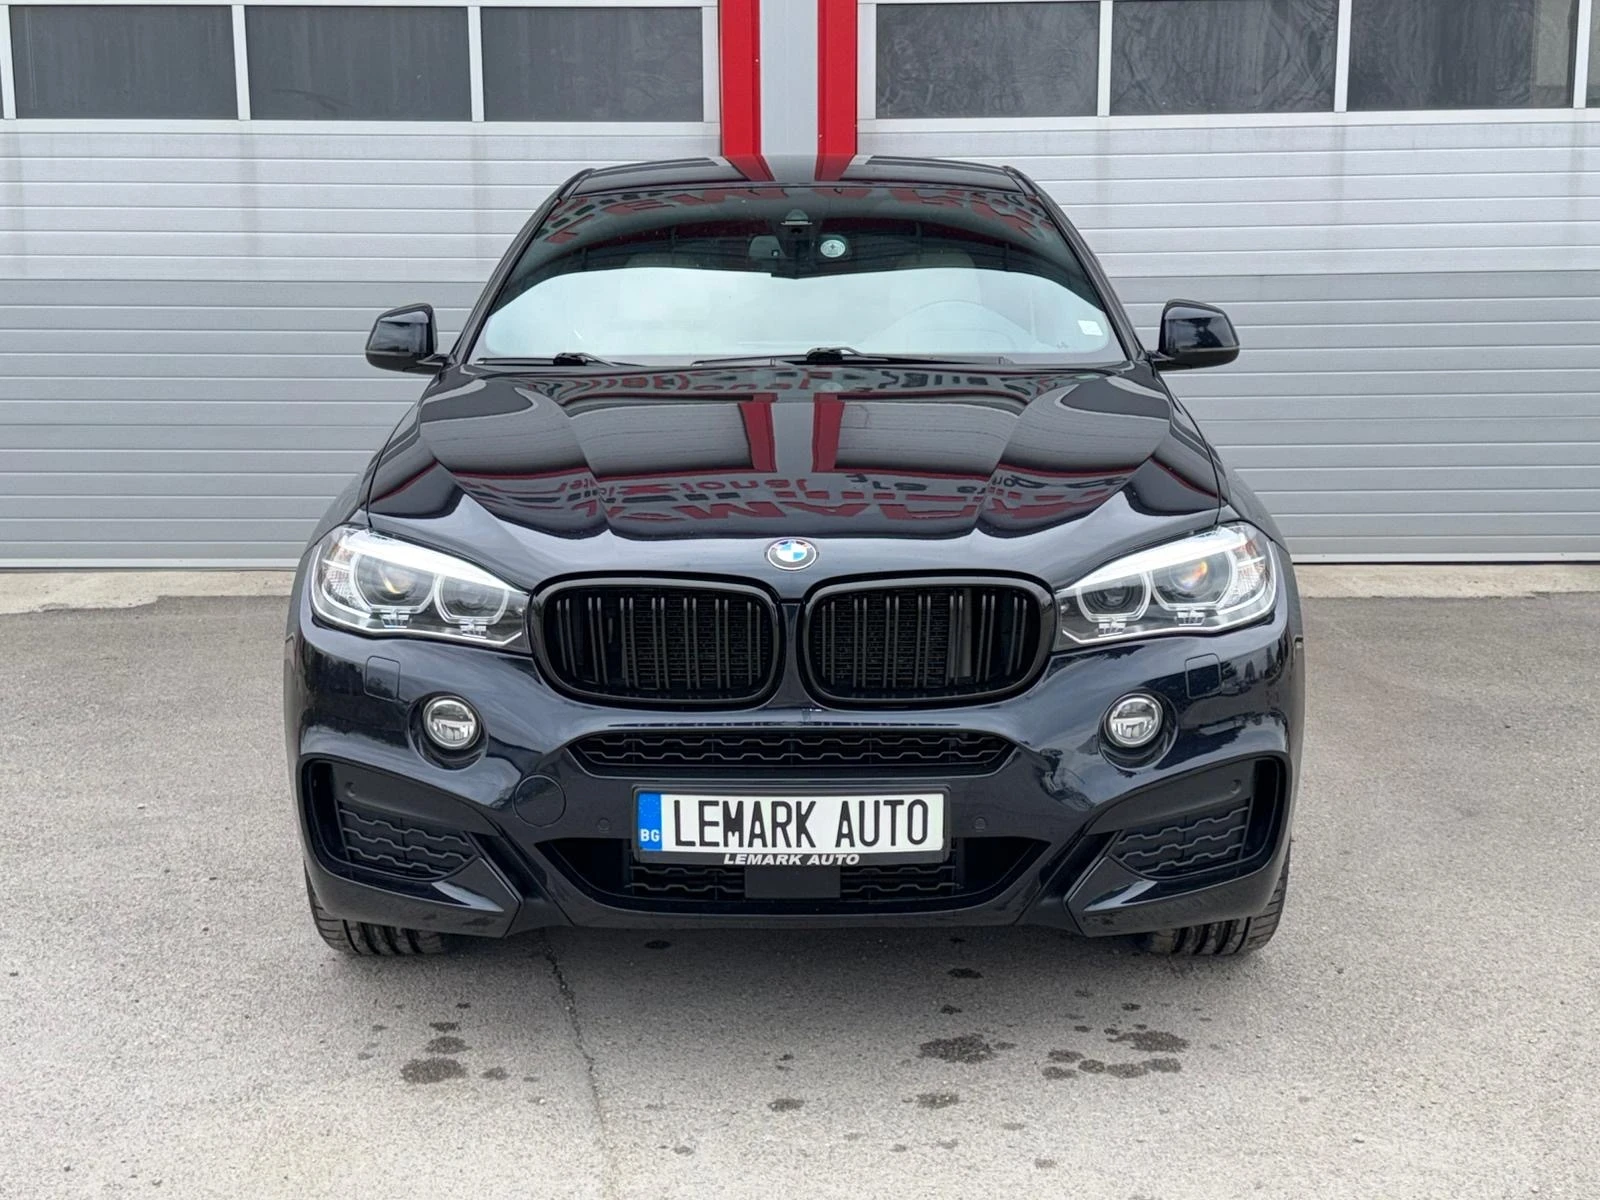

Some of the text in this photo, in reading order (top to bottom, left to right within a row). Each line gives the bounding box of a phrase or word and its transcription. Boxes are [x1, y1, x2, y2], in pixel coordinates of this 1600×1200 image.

[674, 798, 929, 849] LEMARK AUTO
[640, 828, 660, 842] BG
[723, 853, 860, 866] LEMARK AUTO
